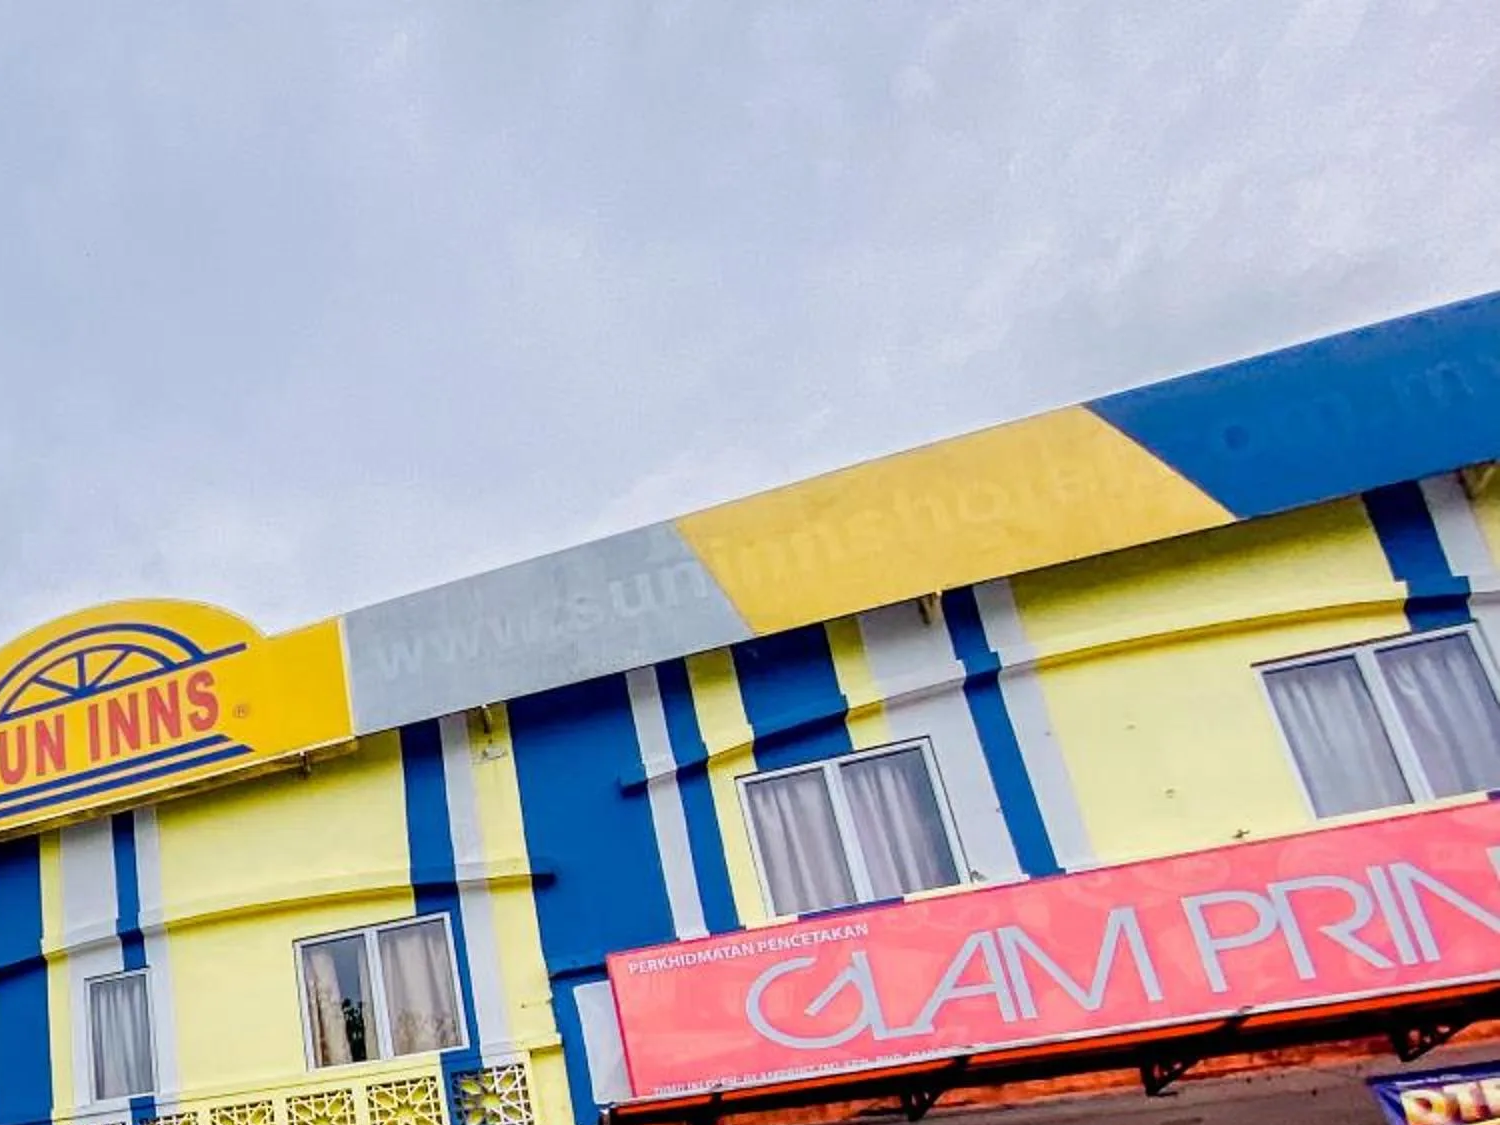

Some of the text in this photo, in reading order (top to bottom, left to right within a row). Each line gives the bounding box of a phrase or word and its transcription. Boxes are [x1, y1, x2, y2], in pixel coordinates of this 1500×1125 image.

[88, 670, 219, 763] INNS
[627, 922, 869, 975] PERKHIDMATAN PENCETAKAN
[746, 906, 1164, 1049] GLAM
